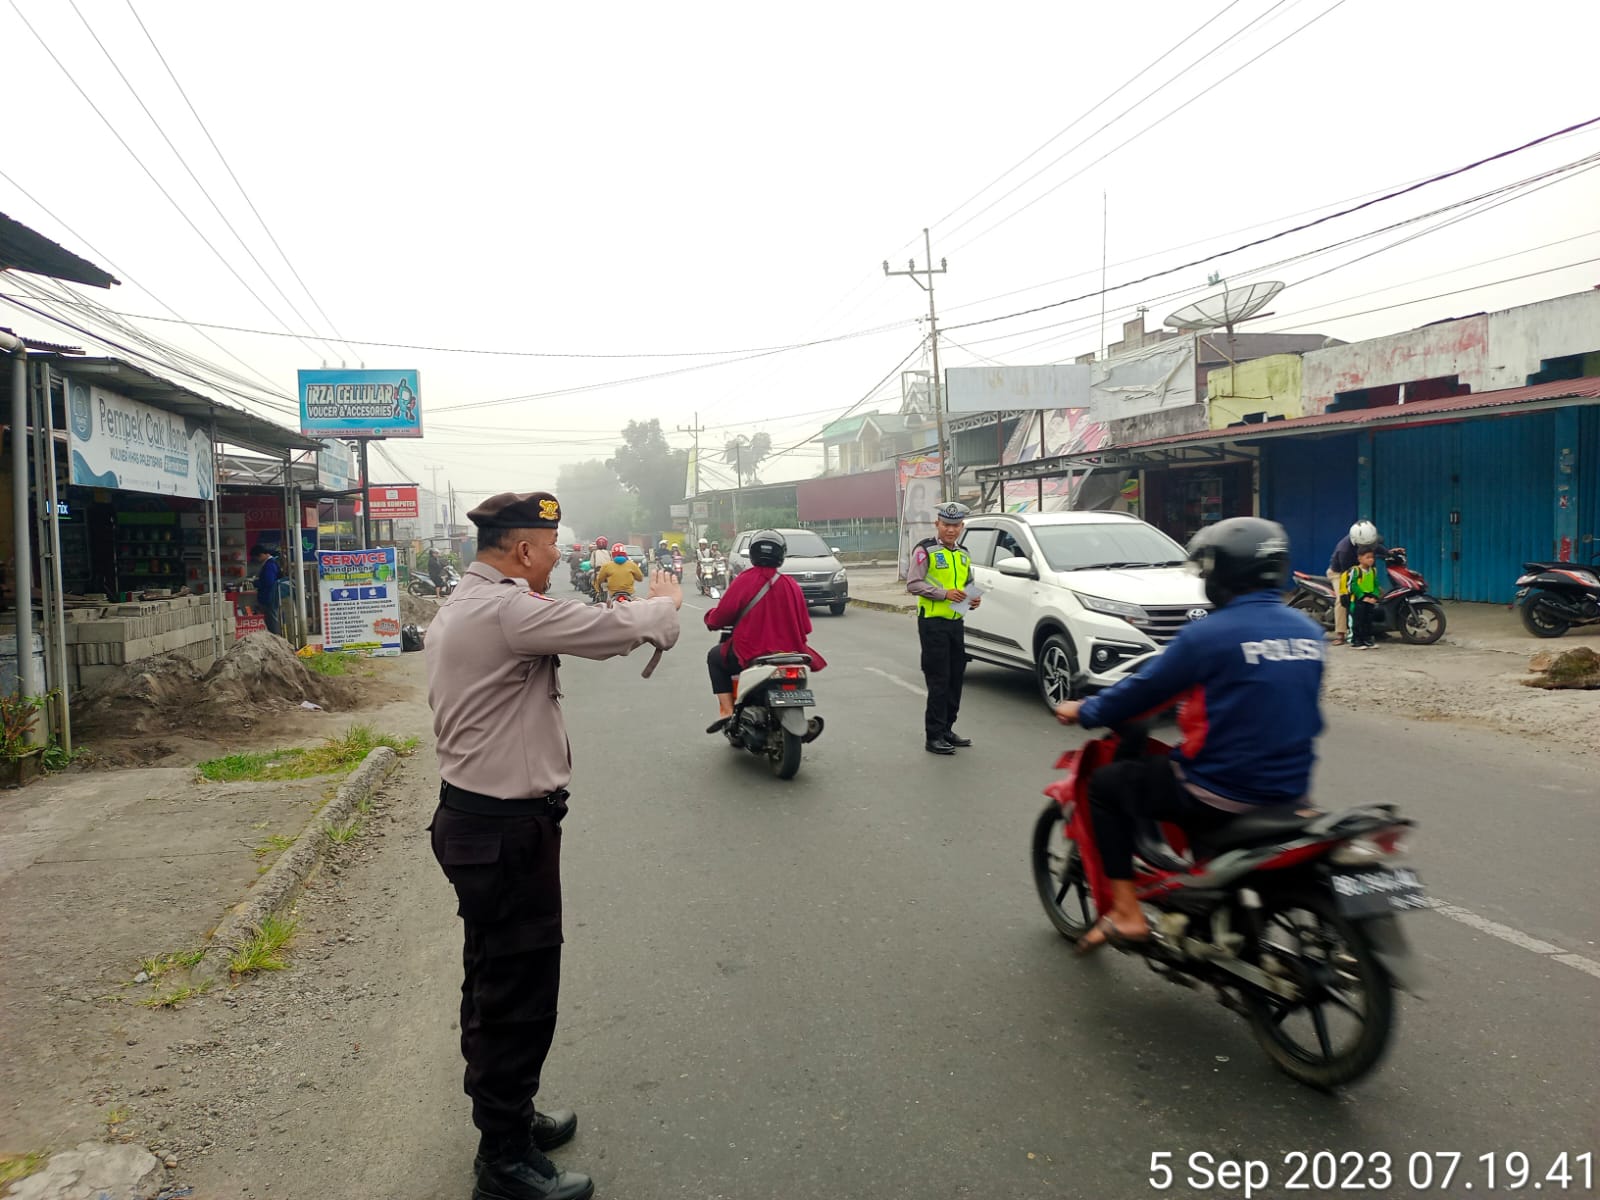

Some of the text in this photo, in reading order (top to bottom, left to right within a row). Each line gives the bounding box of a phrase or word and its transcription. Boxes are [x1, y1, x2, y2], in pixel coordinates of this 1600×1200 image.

[307, 384, 394, 404] IRZA CELLULAR
[308, 405, 338, 418] VOUCER
[346, 405, 393, 418] ACCESORIES
[99, 397, 144, 449] Pempek
[146, 411, 165, 450] Cak
[322, 552, 387, 566] SERVICE
